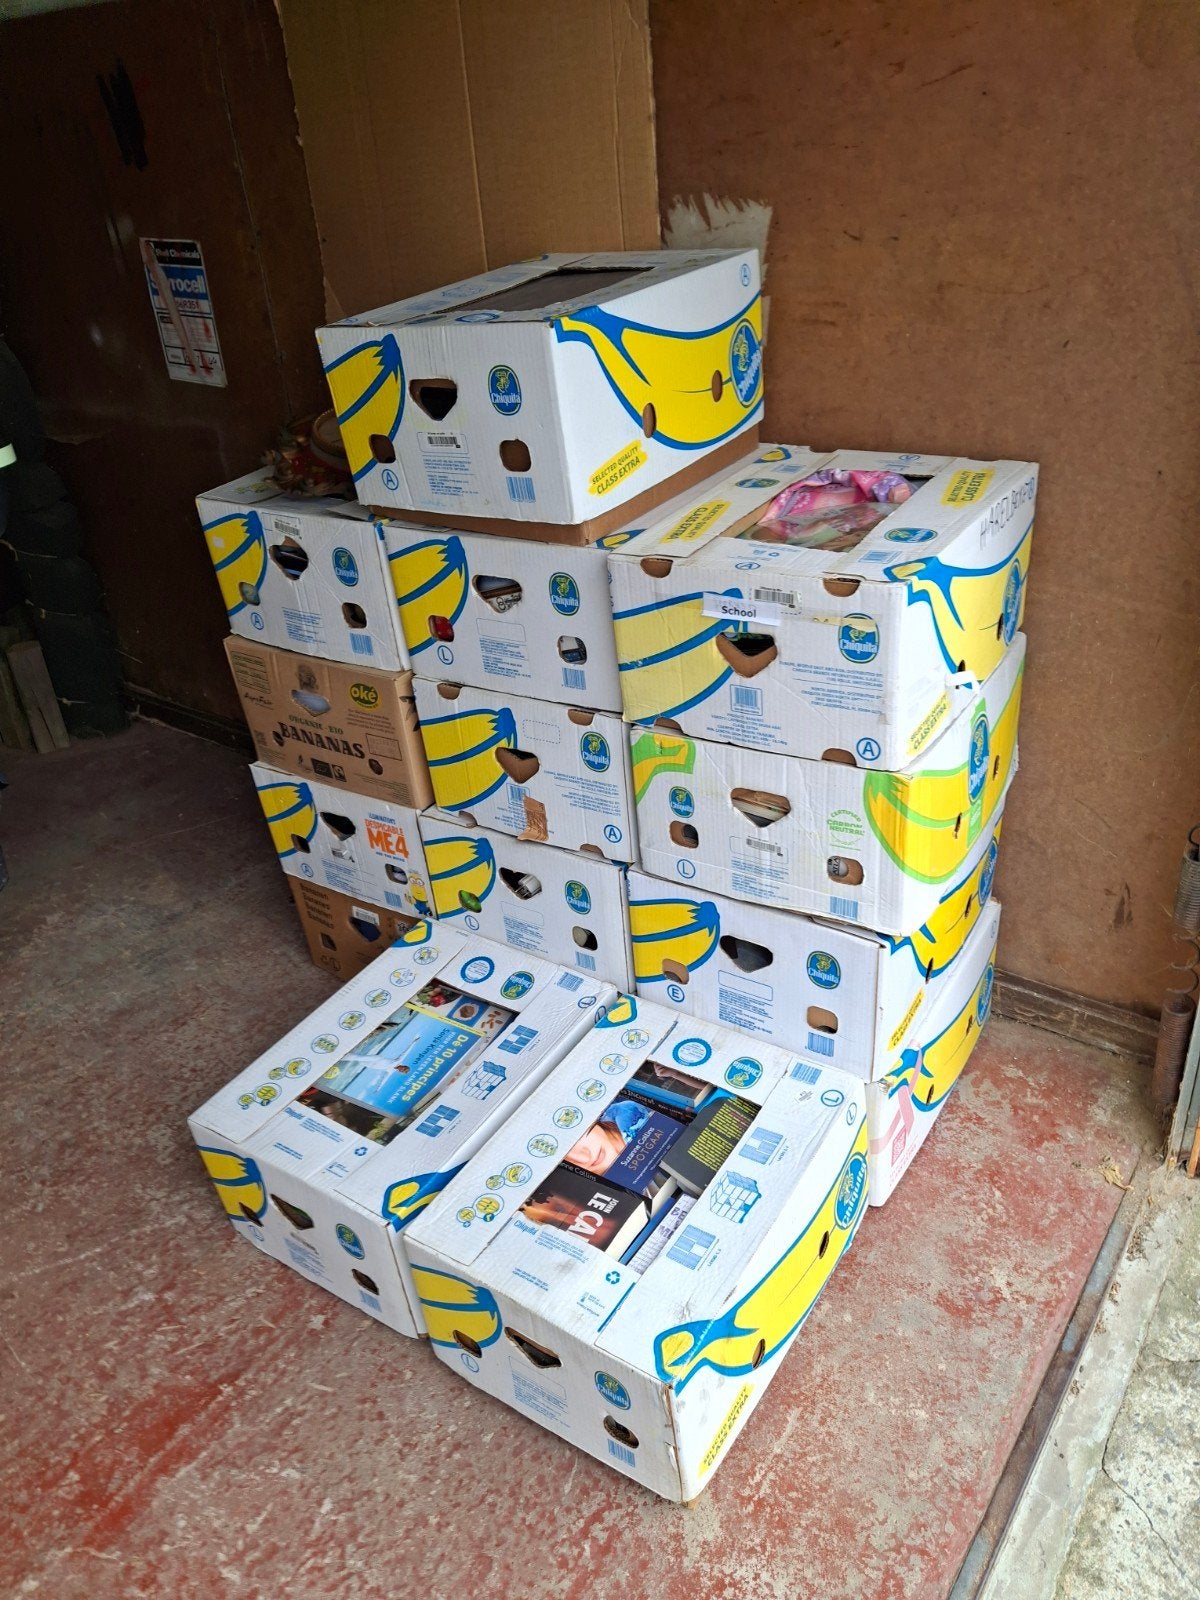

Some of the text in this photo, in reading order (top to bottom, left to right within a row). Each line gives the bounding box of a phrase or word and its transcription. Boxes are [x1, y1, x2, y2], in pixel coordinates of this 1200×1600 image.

[490, 391, 522, 406] Chiquita
[592, 445, 639, 484] SELECTED QUALITY
[597, 456, 641, 495] CLASS EXTRA
[551, 594, 580, 608] Chiquita
[721, 604, 757, 618] School
[839, 638, 878, 655] Chiquita
[350, 682, 379, 704] oké
[277, 721, 366, 760] BANANAS
[862, 740, 875, 757] A
[582, 750, 610, 765] Chiquita
[826, 818, 863, 830] CARBON
[830, 809, 862, 823] CERTIFIED
[829, 825, 865, 837] NEUTRAL
[808, 967, 840, 984] Chiquita
[402, 1033, 469, 1102] Dé 10 principes
[620, 1126, 655, 1168] Suzanne Collins
[628, 1129, 664, 1171] SPOTGAAI
[574, 1166, 597, 1183] Collins
[587, 1191, 609, 1212] LE
[608, 1198, 619, 1214] JOHN
[513, 1219, 539, 1236] Chiquita
